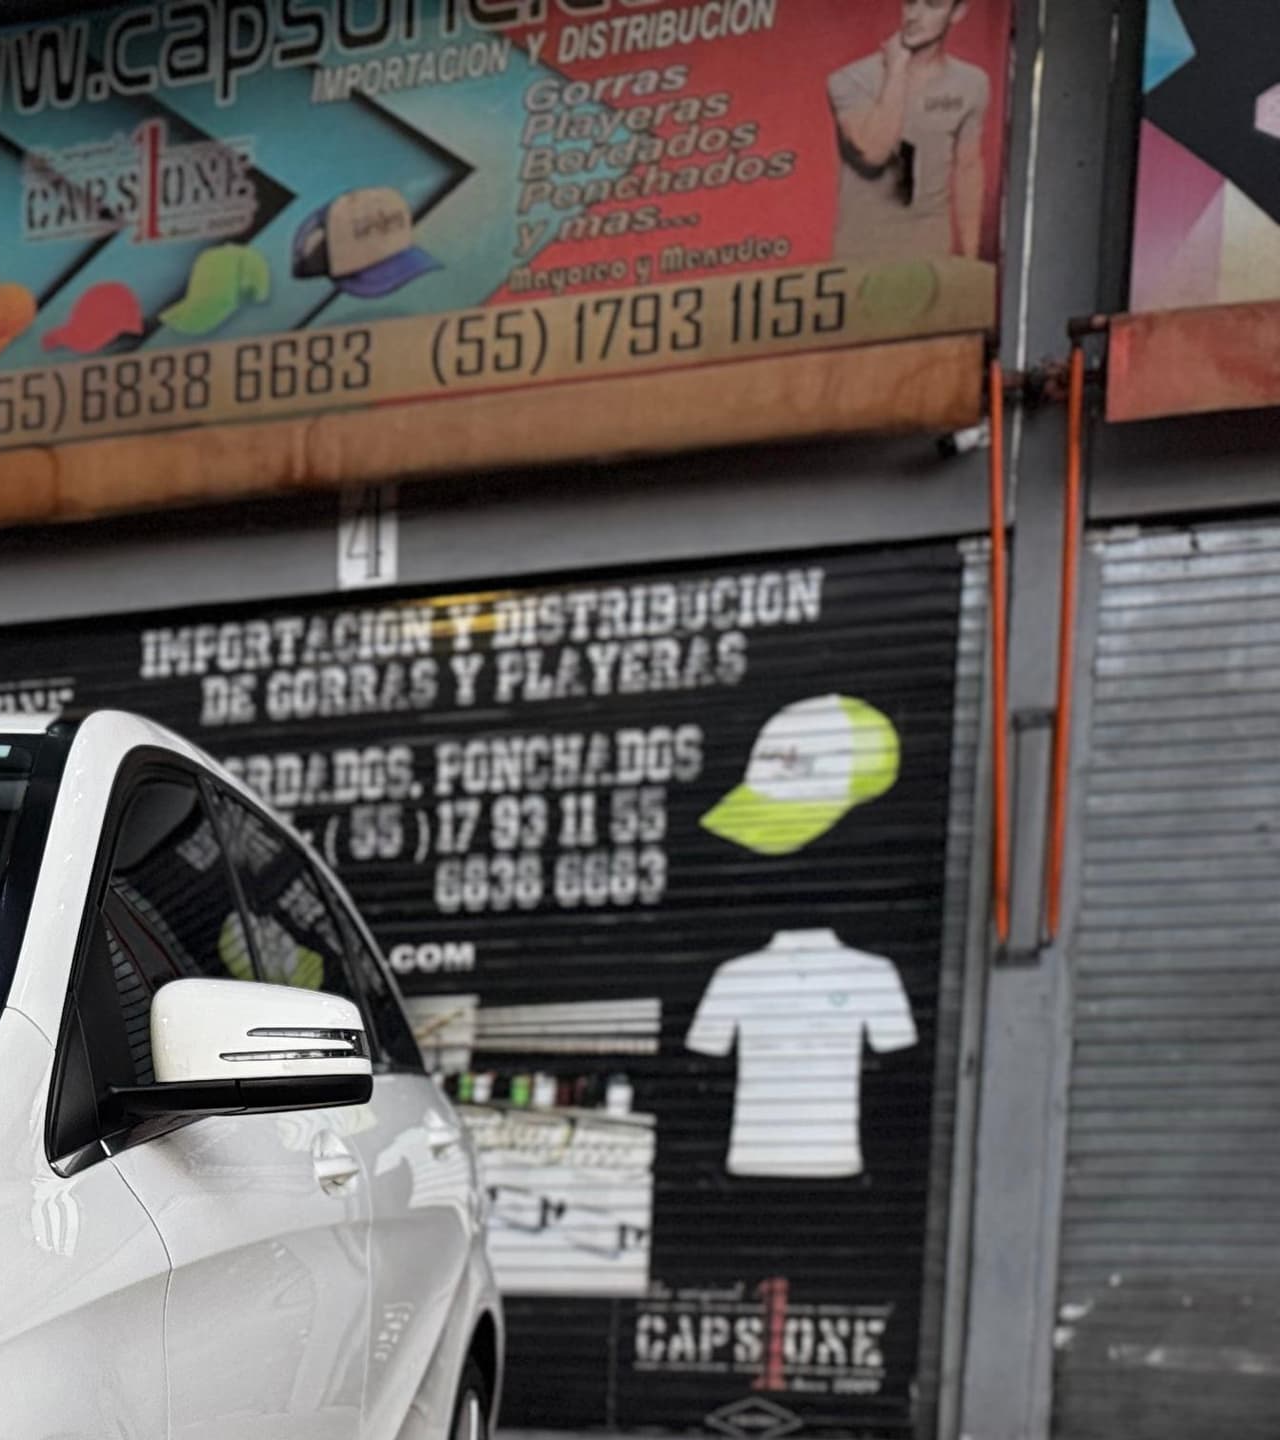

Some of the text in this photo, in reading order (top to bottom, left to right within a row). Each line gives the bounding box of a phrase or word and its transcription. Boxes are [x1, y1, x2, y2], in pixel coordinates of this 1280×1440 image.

[526, 33, 546, 64] Y
[525, 64, 688, 112] Gorras
[522, 92, 730, 145] Playeras
[521, 122, 759, 180] Bordados
[517, 151, 796, 215] Ponchados
[508, 237, 790, 296] Mayoreo y Menudeo
[515, 217, 546, 258] y
[81, 350, 213, 426] 6838
[233, 330, 372, 402] 6683
[430, 307, 550, 386] (55)
[574, 287, 703, 364] 1793
[731, 268, 847, 344] 1155
[141, 569, 825, 678] IMPORTACION Y DISTRIBUCION
[200, 632, 748, 726] DE GORRAS Y PLAYERAS
[436, 724, 703, 796] PONCHADOS
[435, 799, 481, 854] 17
[490, 797, 548, 850] 93
[558, 793, 597, 846] 11
[609, 786, 668, 844] 55
[635, 1313, 764, 1363] CAPS
